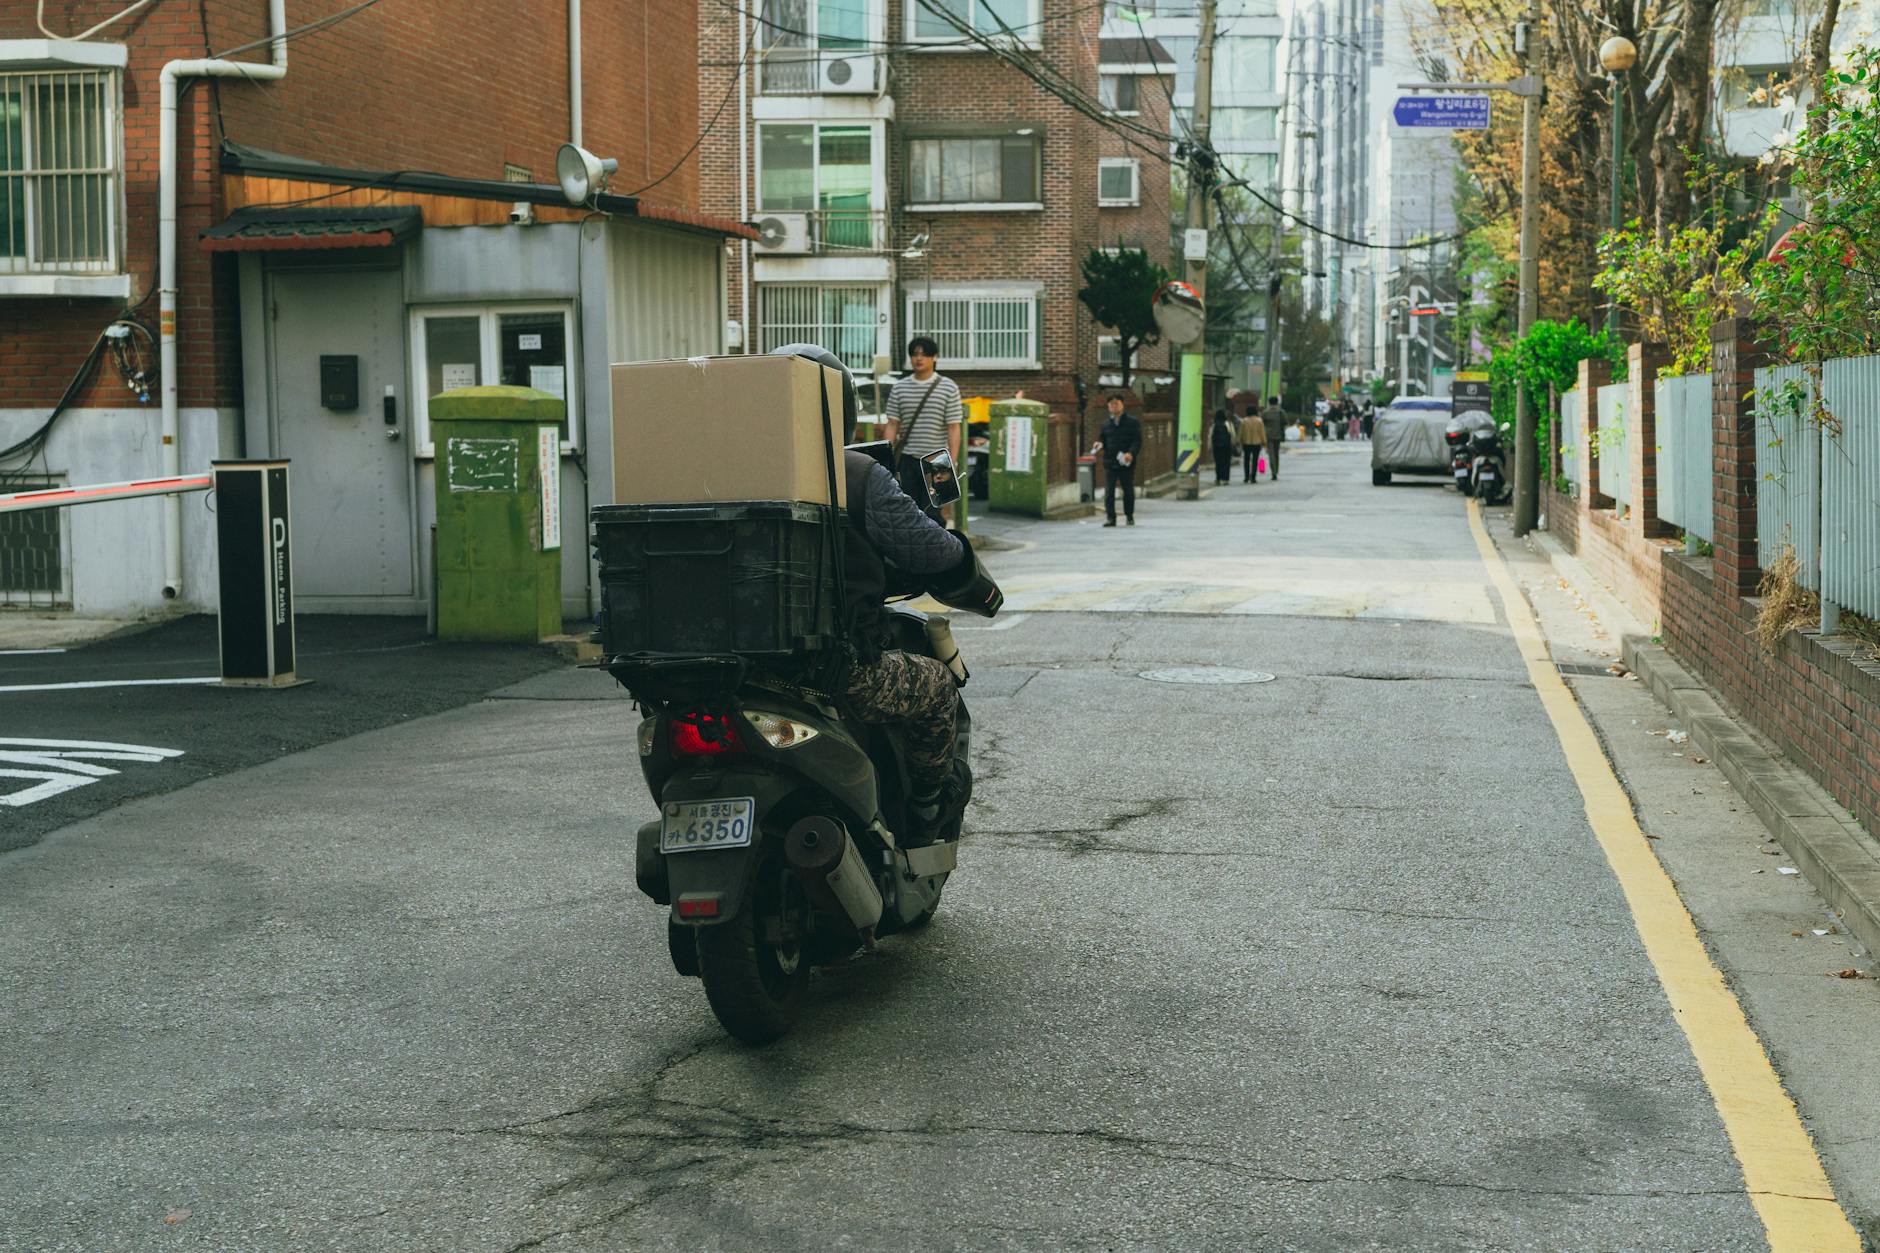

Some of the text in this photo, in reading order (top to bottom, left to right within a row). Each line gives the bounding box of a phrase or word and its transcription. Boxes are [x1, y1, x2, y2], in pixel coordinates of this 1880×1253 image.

[688, 804, 732, 818] 서울 광진
[667, 818, 745, 844] 카 6350
